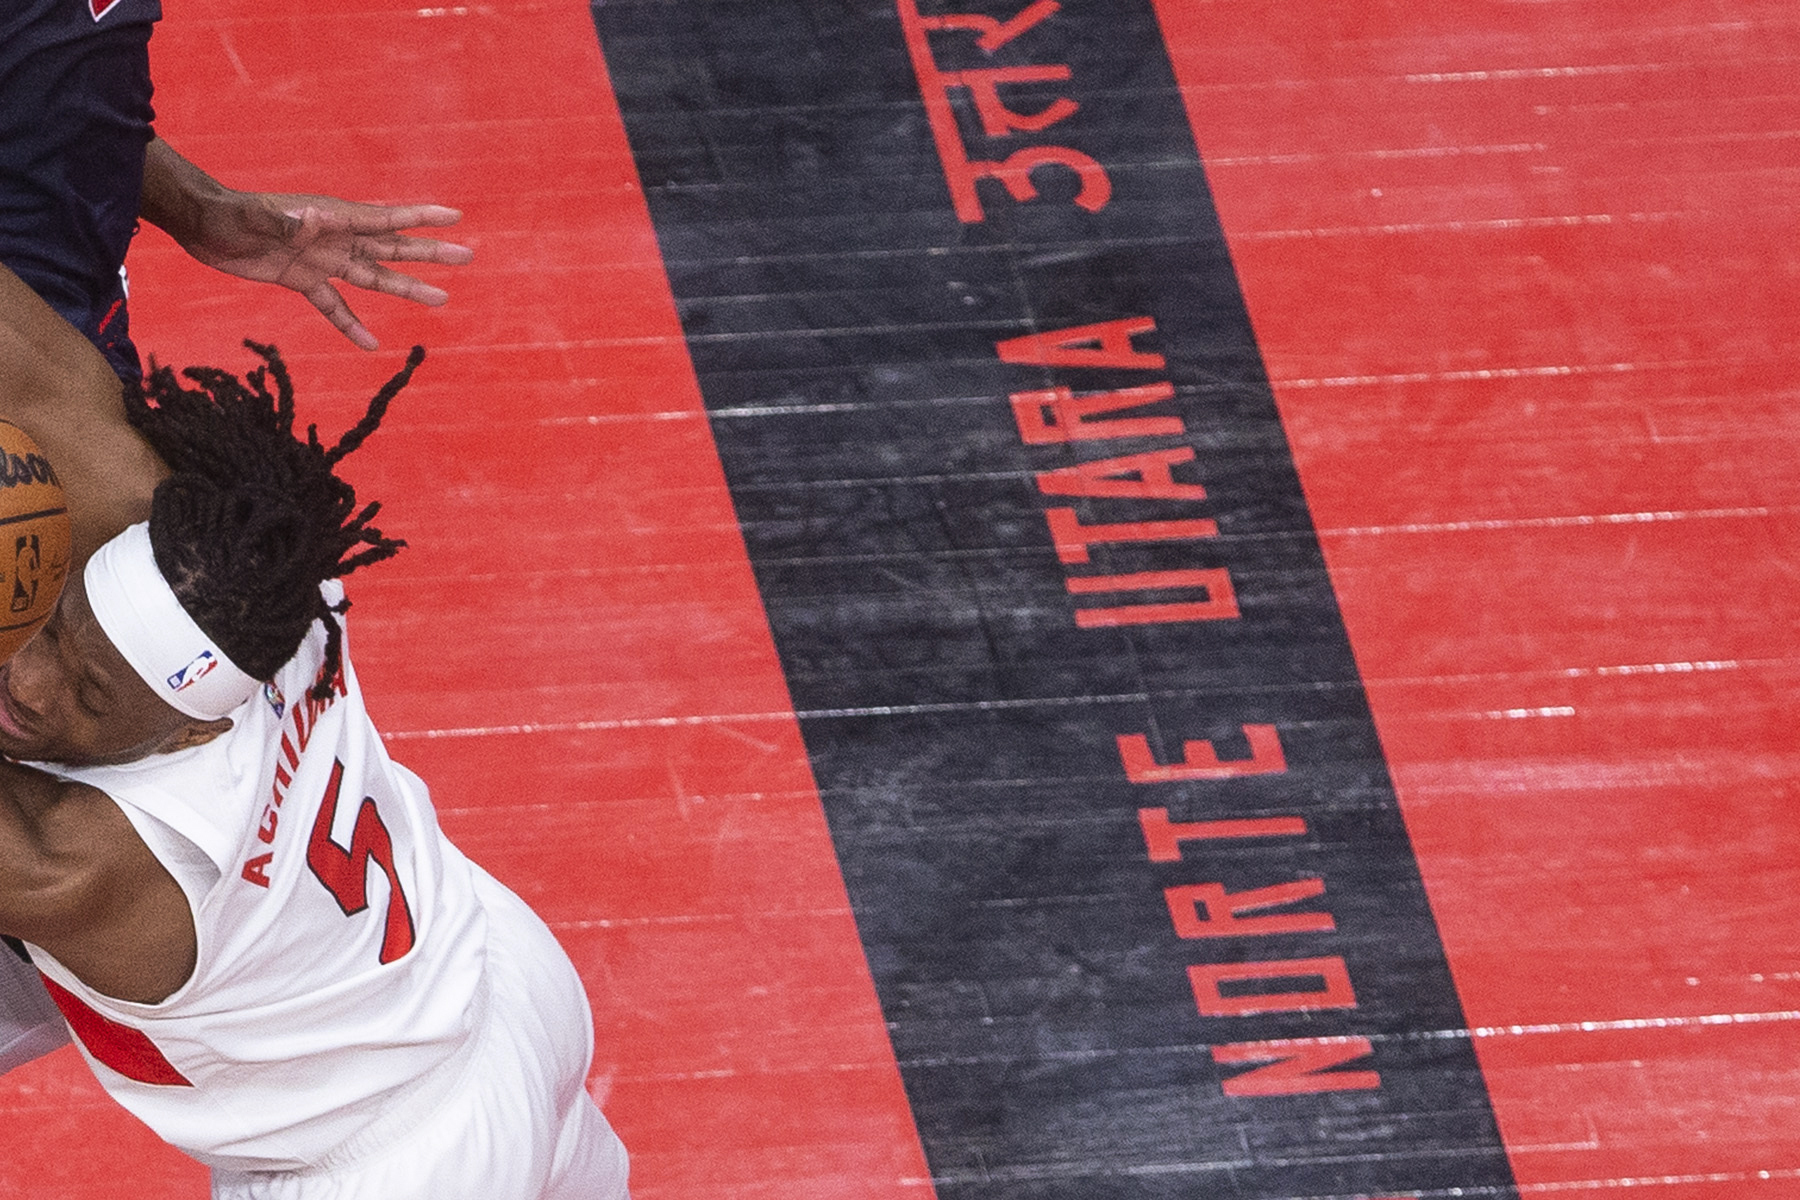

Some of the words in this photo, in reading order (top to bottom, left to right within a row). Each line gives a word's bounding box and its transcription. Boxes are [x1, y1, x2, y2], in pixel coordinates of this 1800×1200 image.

[996, 316, 1241, 628] UTARA
[306, 756, 414, 965] 5
[1116, 723, 1381, 1097] NORTE
